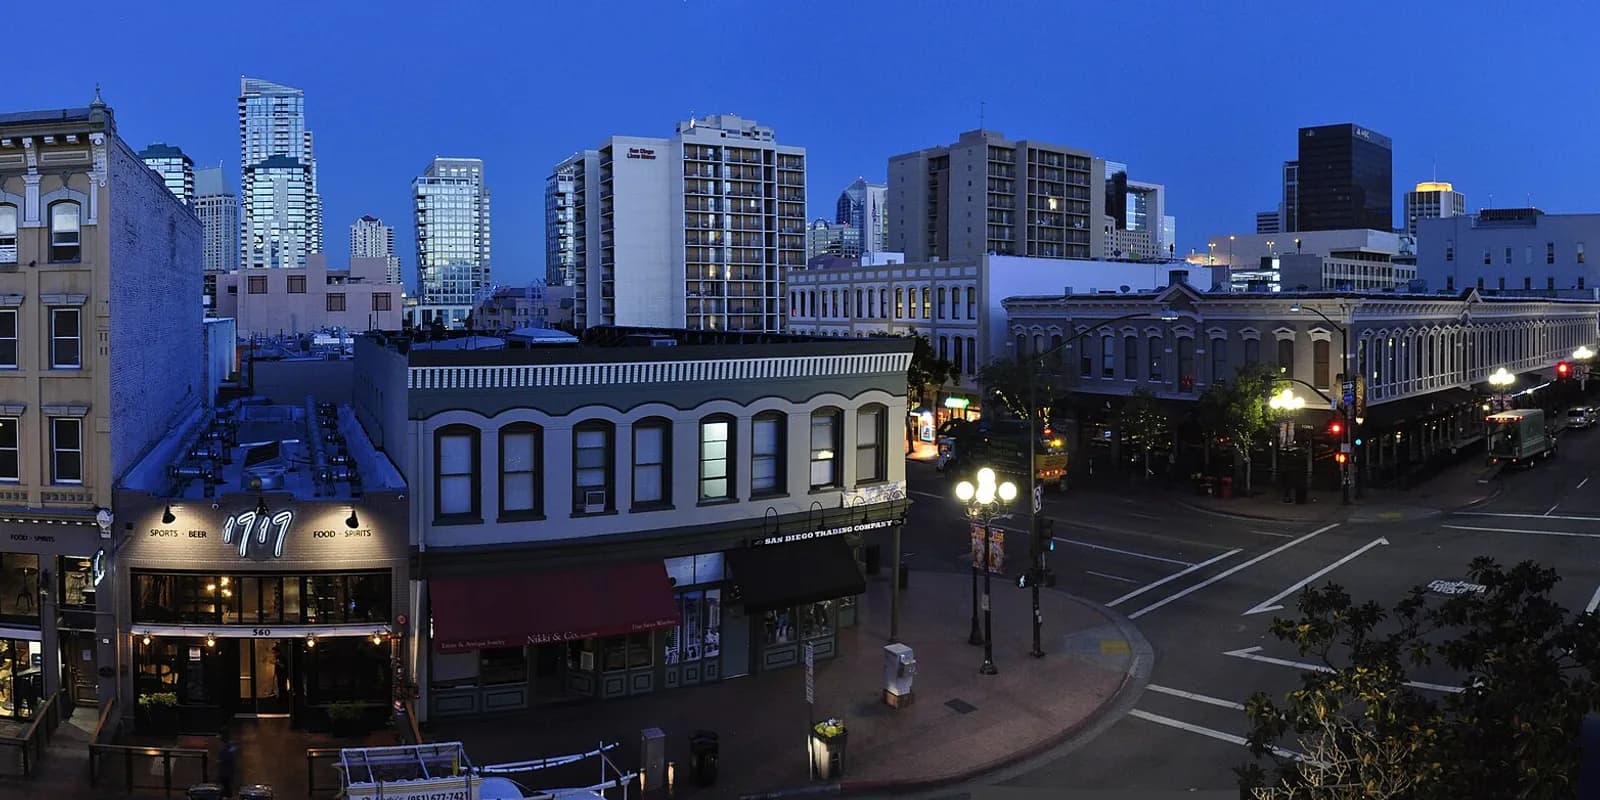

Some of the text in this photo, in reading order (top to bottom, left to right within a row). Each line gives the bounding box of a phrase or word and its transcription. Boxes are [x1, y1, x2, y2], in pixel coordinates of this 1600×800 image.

[150, 529, 207, 538] SPORTS BEER
[223, 510, 293, 558] 1919
[313, 529, 371, 538] FOOD SPIRITS
[764, 520, 893, 545] SAN DIEGO TRADING COMPANY
[252, 628, 271, 636] 560
[552, 632, 561, 641] &
